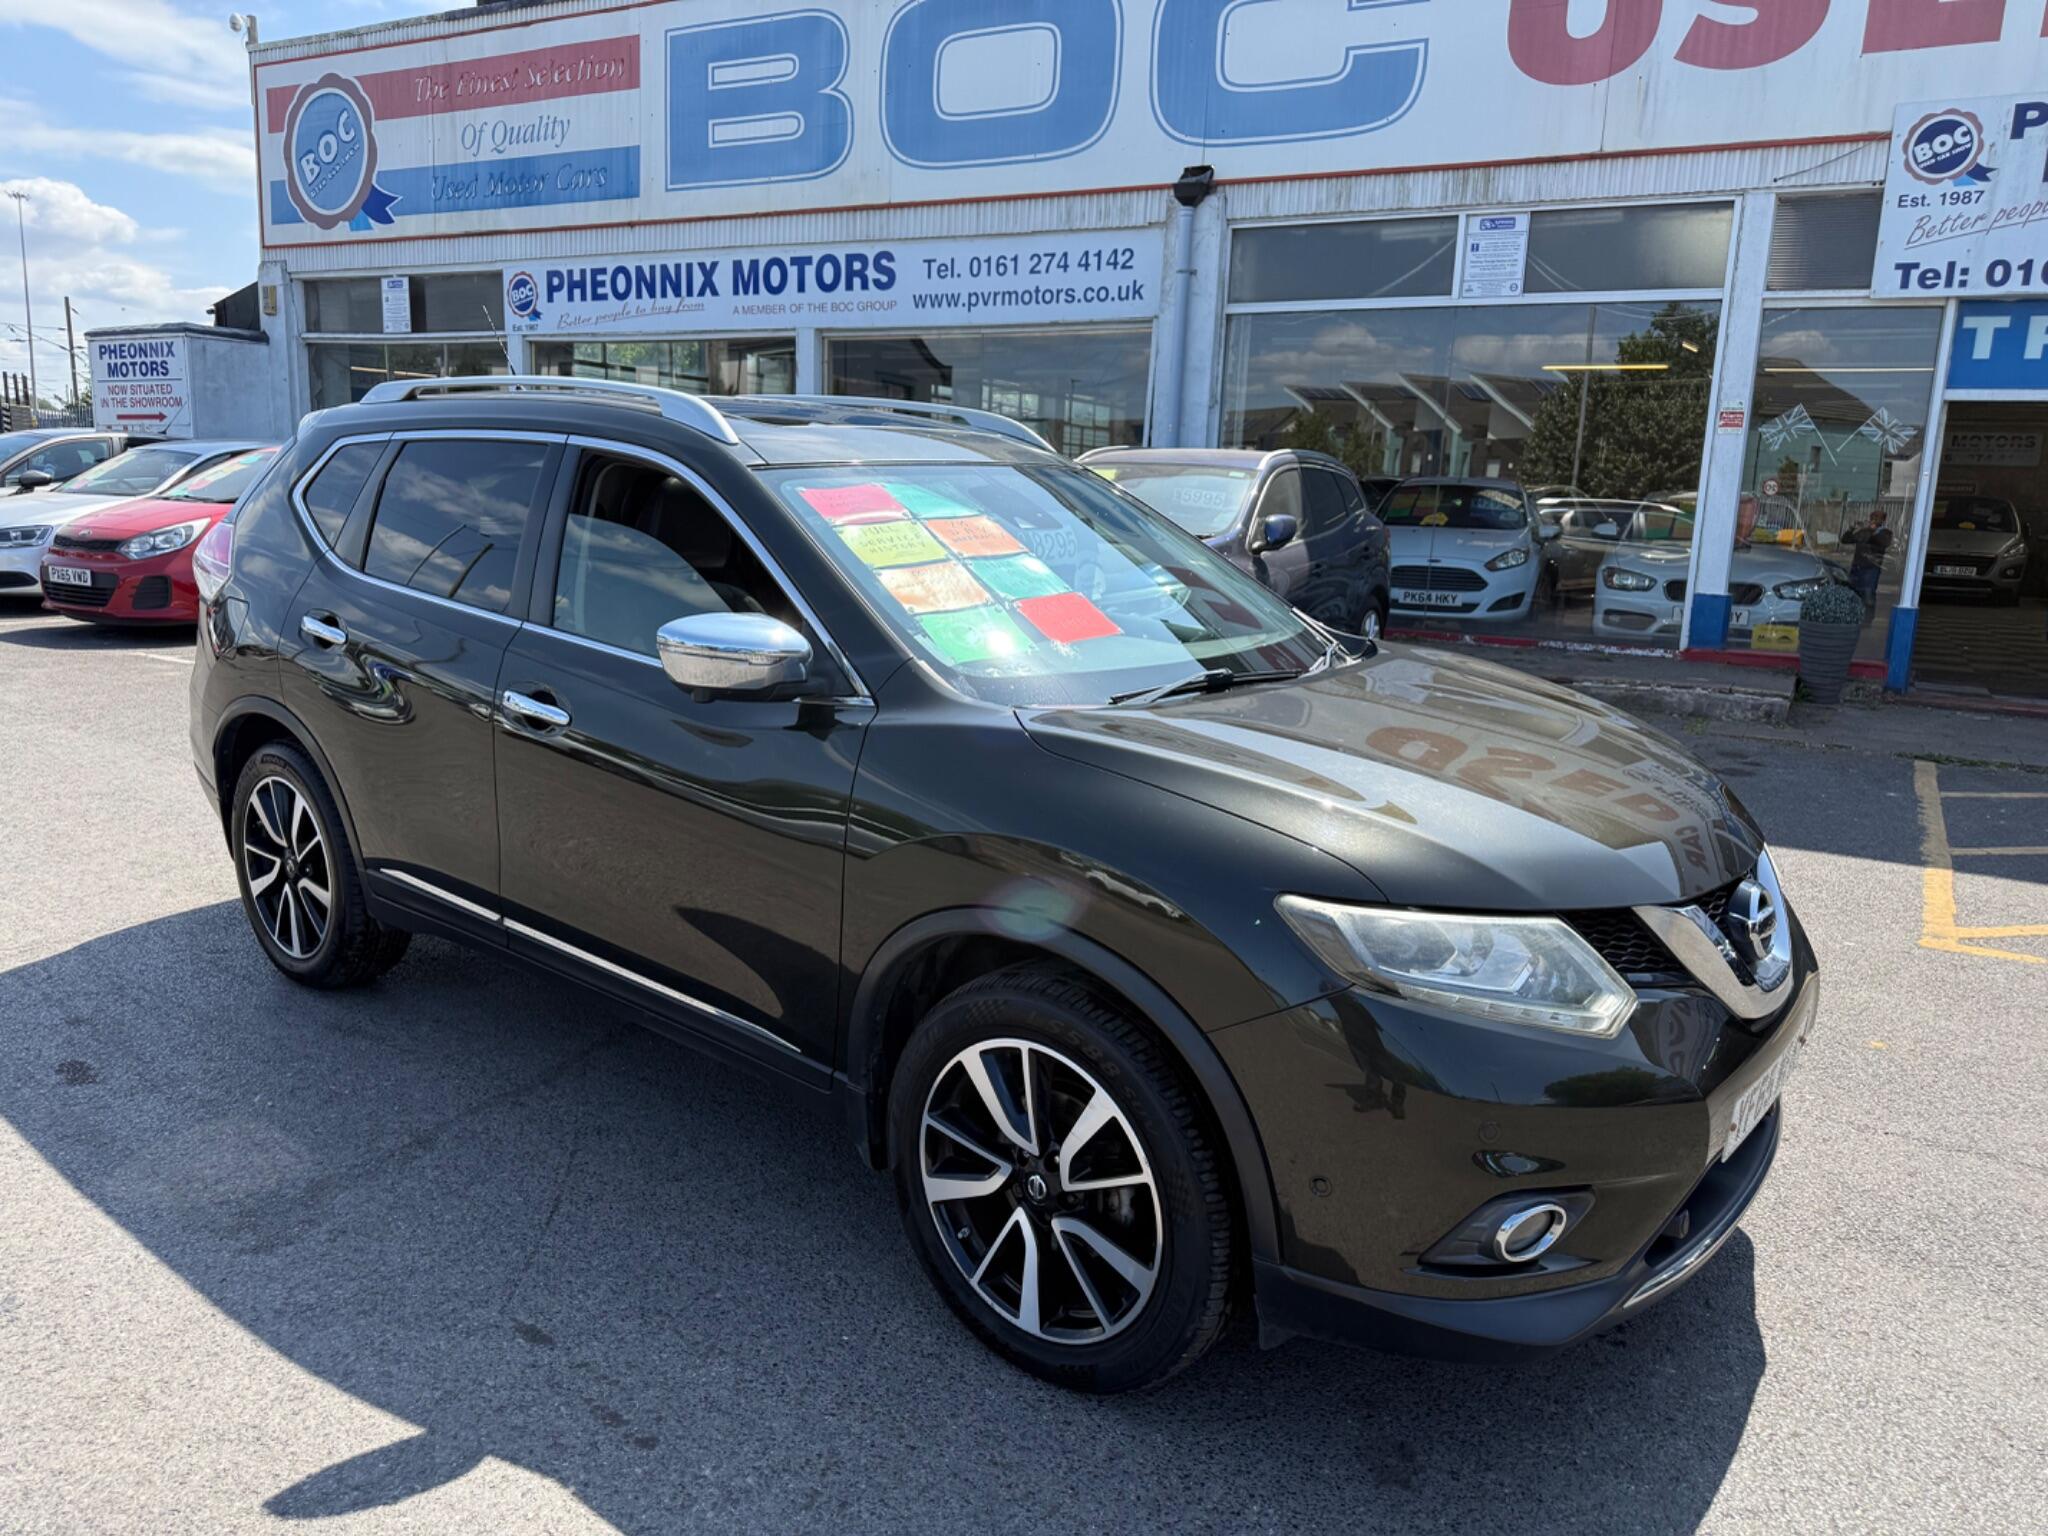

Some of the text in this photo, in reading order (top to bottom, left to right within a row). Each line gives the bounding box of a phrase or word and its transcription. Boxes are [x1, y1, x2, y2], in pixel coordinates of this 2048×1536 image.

[415, 55, 625, 102] The Finest Selection
[664, 0, 1428, 190] BOC
[300, 109, 356, 185] BOC
[461, 115, 571, 157] Of Quality
[1913, 125, 1972, 163] BOC
[431, 163, 608, 201] Used Motor Cars
[1897, 190, 1985, 208] Est. 1987
[1906, 212, 1988, 245] Better
[546, 250, 897, 303] PHEONNIX MOTORS
[923, 247, 1135, 280] Tel. 0161 274 4142
[1894, 260, 1970, 289] Tel:
[511, 283, 534, 301] BOC
[732, 300, 897, 315] A MEMBER OF THE BOC GROUP
[913, 279, 1145, 312] www.pvrmotors.co.uk
[557, 315, 592, 329] Better
[594, 303, 631, 326] people
[635, 304, 646, 315] to
[675, 297, 705, 314] from
[98, 341, 175, 360] PHEONNIX
[107, 360, 169, 378] MOTORS
[100, 396, 183, 408] IN THE SHOWROOM
[107, 383, 173, 395] NOW SITUATED
[1435, 593, 1458, 604] HKY
